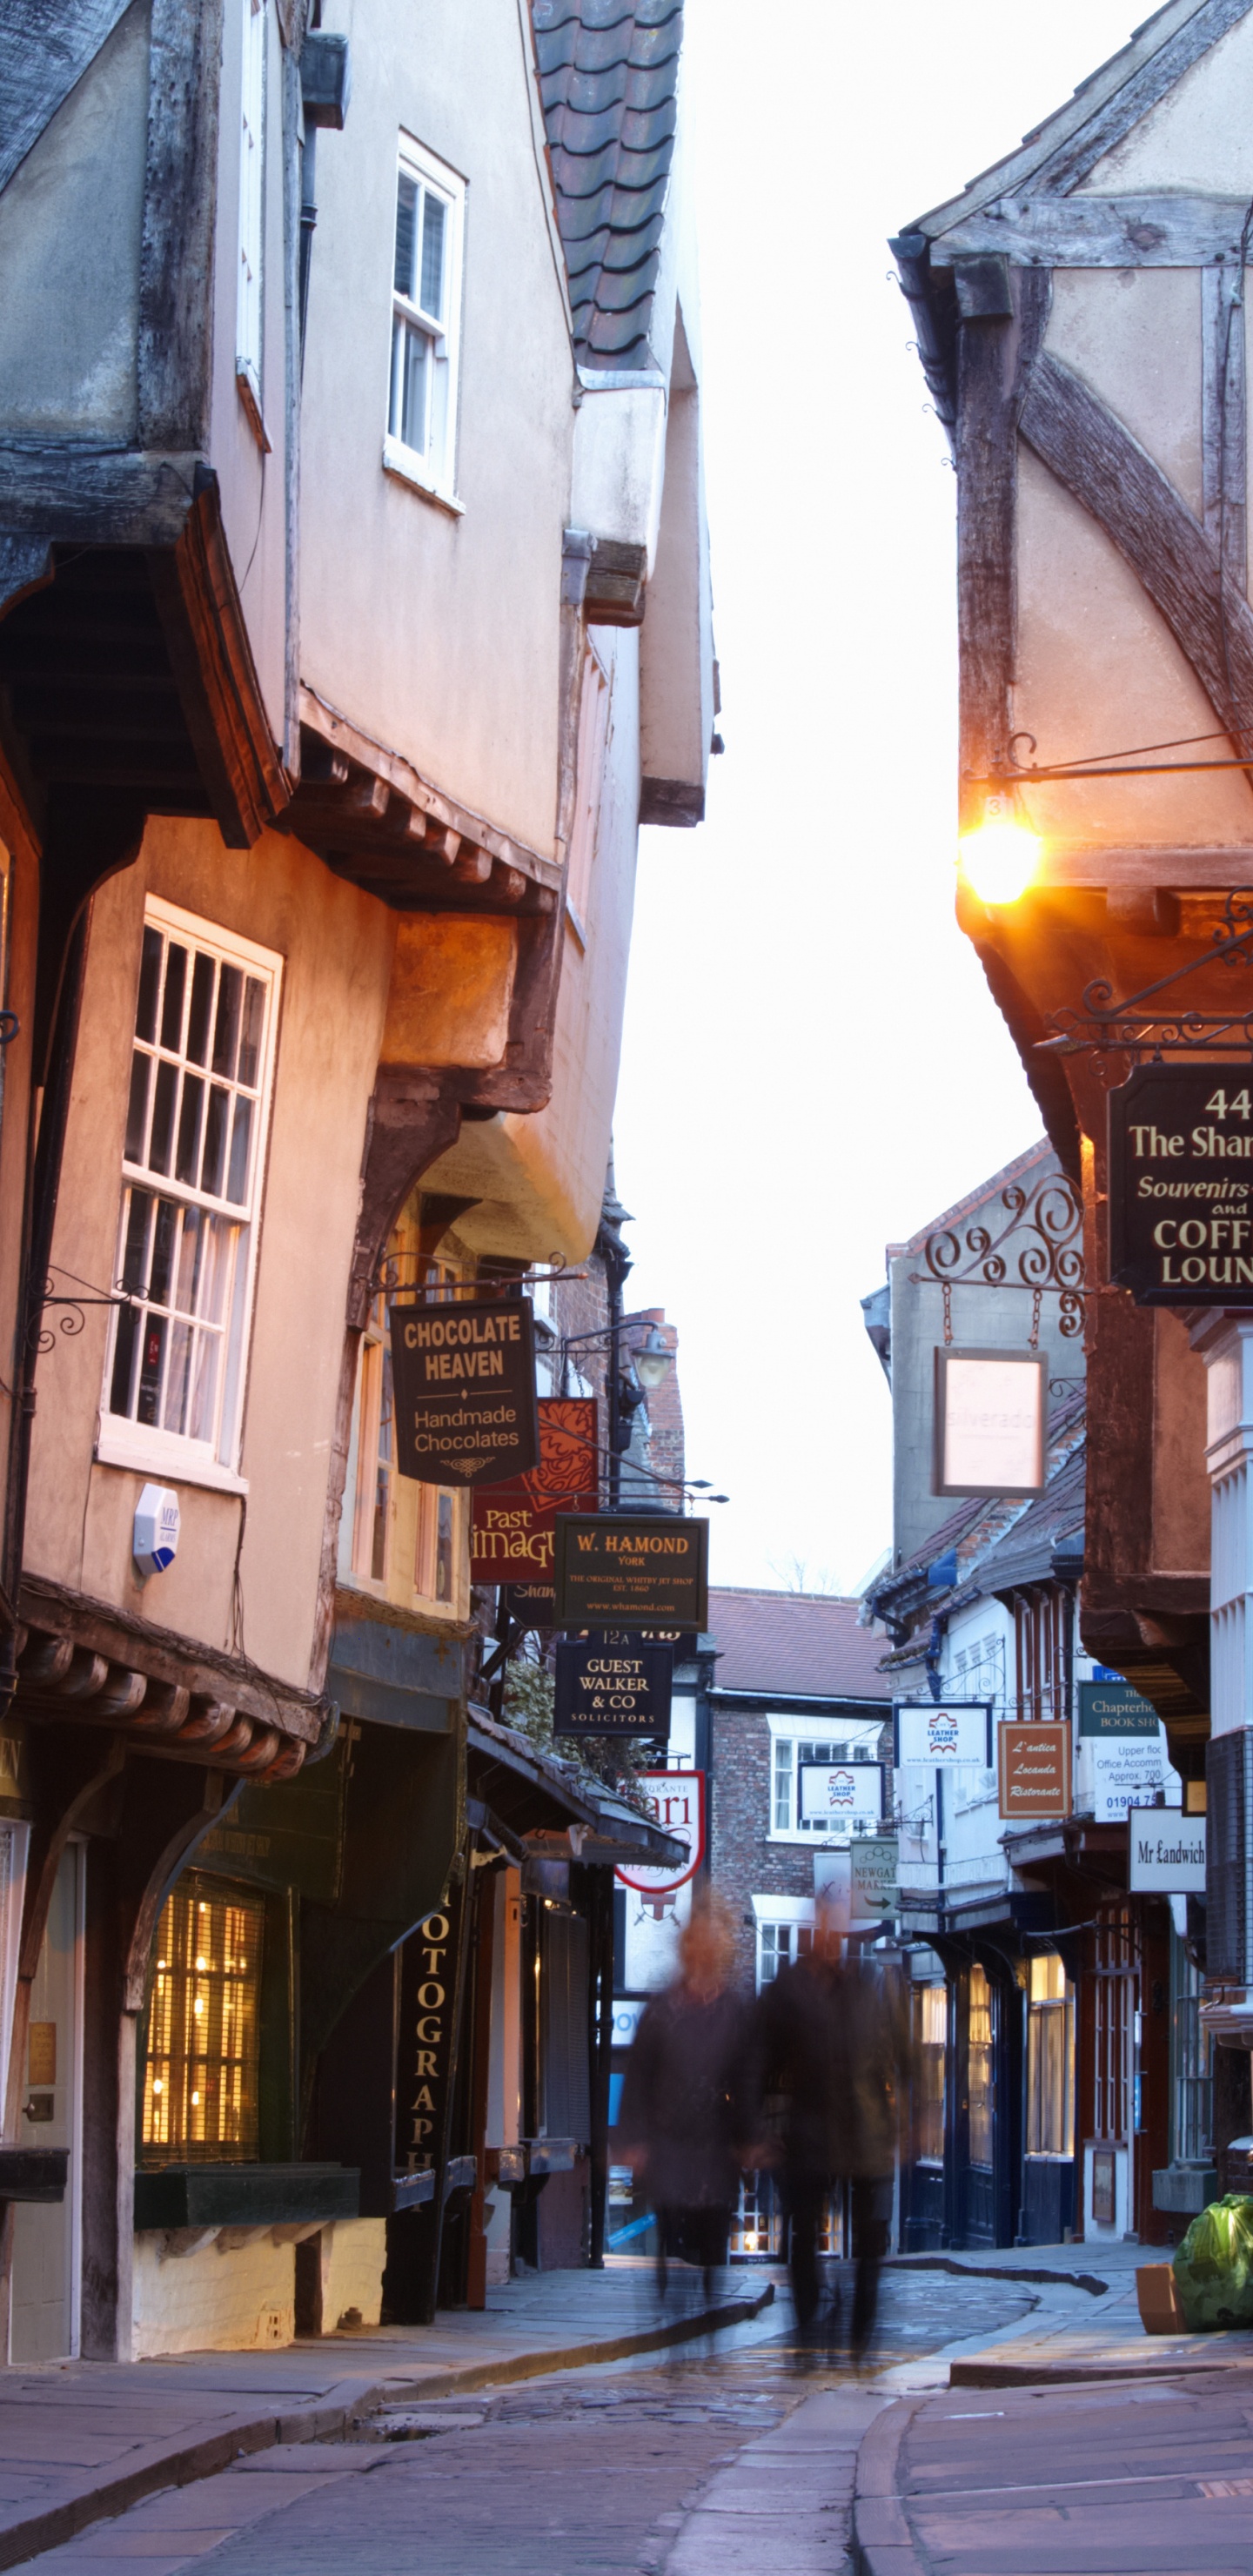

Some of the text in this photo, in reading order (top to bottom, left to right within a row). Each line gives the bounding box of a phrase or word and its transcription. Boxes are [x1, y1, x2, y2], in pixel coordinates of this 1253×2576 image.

[988, 798, 1002, 816] 3
[1205, 1089, 1252, 1120] 44
[1129, 1125, 1184, 1157] The
[1137, 1175, 1250, 1198] Souvenirs
[1211, 1203, 1248, 1215] and
[1153, 1219, 1252, 1250] COFF
[1162, 1256, 1253, 1284] LOUN
[404, 1315, 520, 1349] CHOCOLATE
[425, 1350, 503, 1380] HEAVEN
[414, 1405, 517, 1429] Handmade
[414, 1430, 519, 1452] Chocolates
[160, 1506, 178, 1526] MRP
[486, 1510, 533, 1529] Past
[159, 1531, 177, 1543] ALARMS
[577, 1532, 689, 1554] W. HAMOND
[618, 1555, 646, 1566] YORK
[569, 1574, 585, 1583] THE
[586, 1575, 624, 1584] ORIGINAL
[626, 1576, 658, 1585] WHITBY
[658, 1577, 671, 1587] JET
[586, 1601, 675, 1613] www.whamond.com
[586, 1658, 643, 1674] GUEST
[579, 1676, 650, 1692] WALKER
[591, 1695, 636, 1709] & CO
[1091, 1700, 1156, 1717] Chapterho
[571, 1714, 655, 1724] SOLICITORS
[1100, 1717, 1136, 1727] BOOK
[1118, 1746, 1144, 1757] Upper
[1013, 1763, 1057, 1775] Locanda
[1096, 1760, 1122, 1769] Office
[1109, 1769, 1161, 1781] Approx. 700
[1009, 1785, 1062, 1797] Ristorante
[1106, 1795, 1140, 1808] 01904
[1137, 1840, 1154, 1863] Mr
[854, 1867, 896, 1878] NEWGAT
[857, 1880, 897, 1890] MARKE
[406, 1888, 452, 2213] OTOGRAPH
